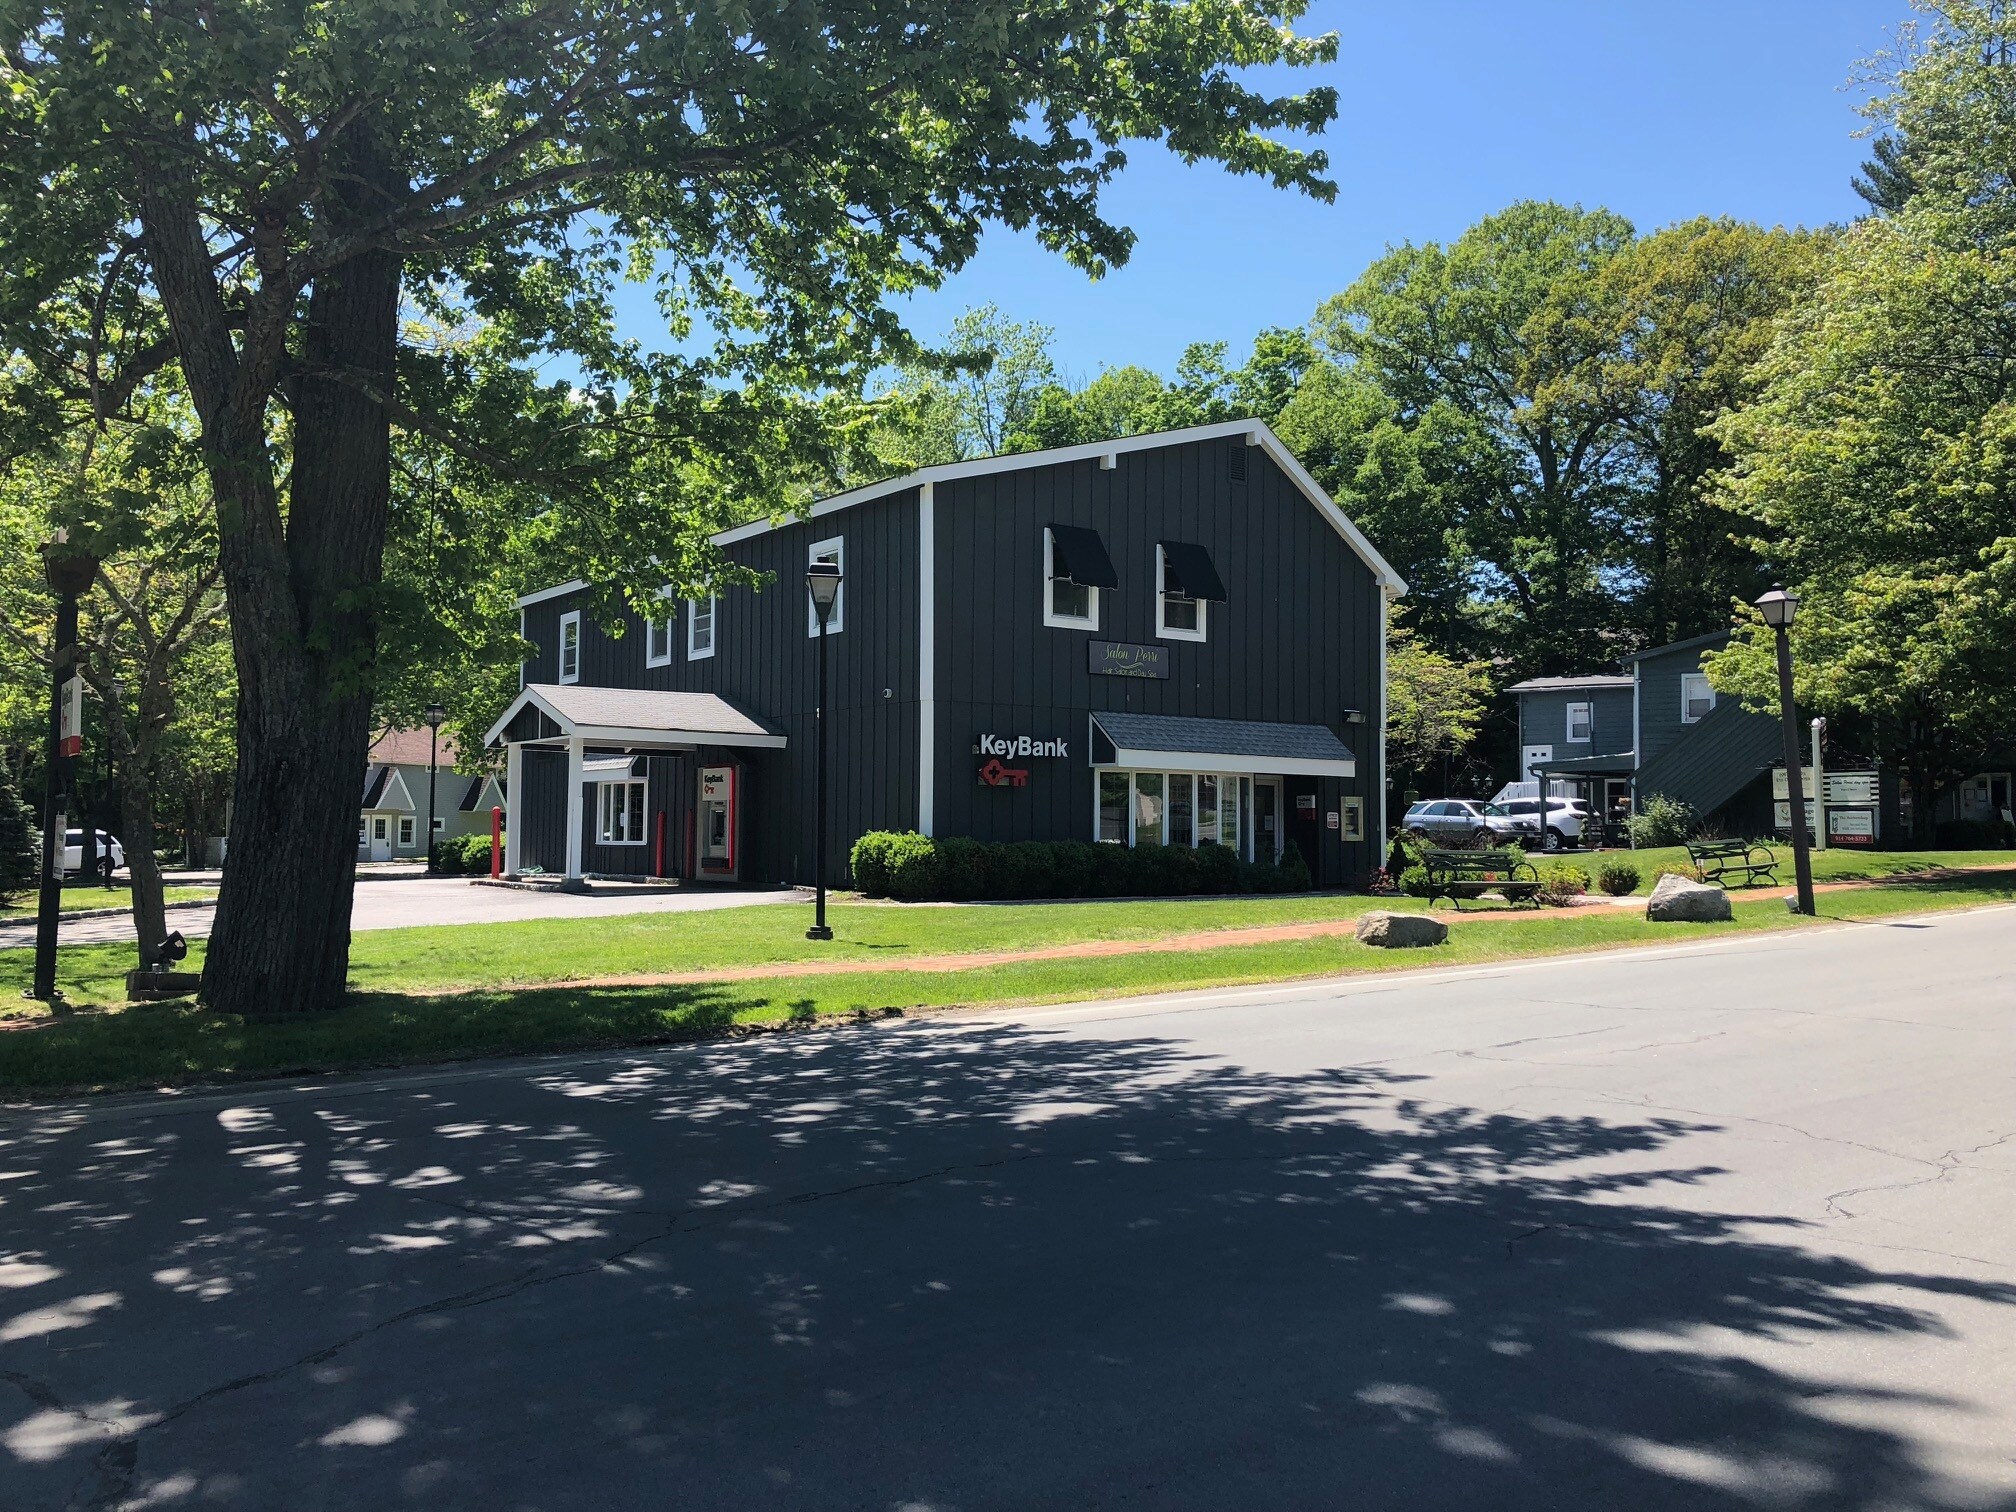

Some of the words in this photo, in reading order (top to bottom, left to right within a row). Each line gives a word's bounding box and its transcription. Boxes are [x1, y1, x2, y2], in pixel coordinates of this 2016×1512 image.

[1102, 643, 1129, 660] Salon
[981, 734, 1068, 760] KeyBank
[704, 774, 724, 785] KeyBank
